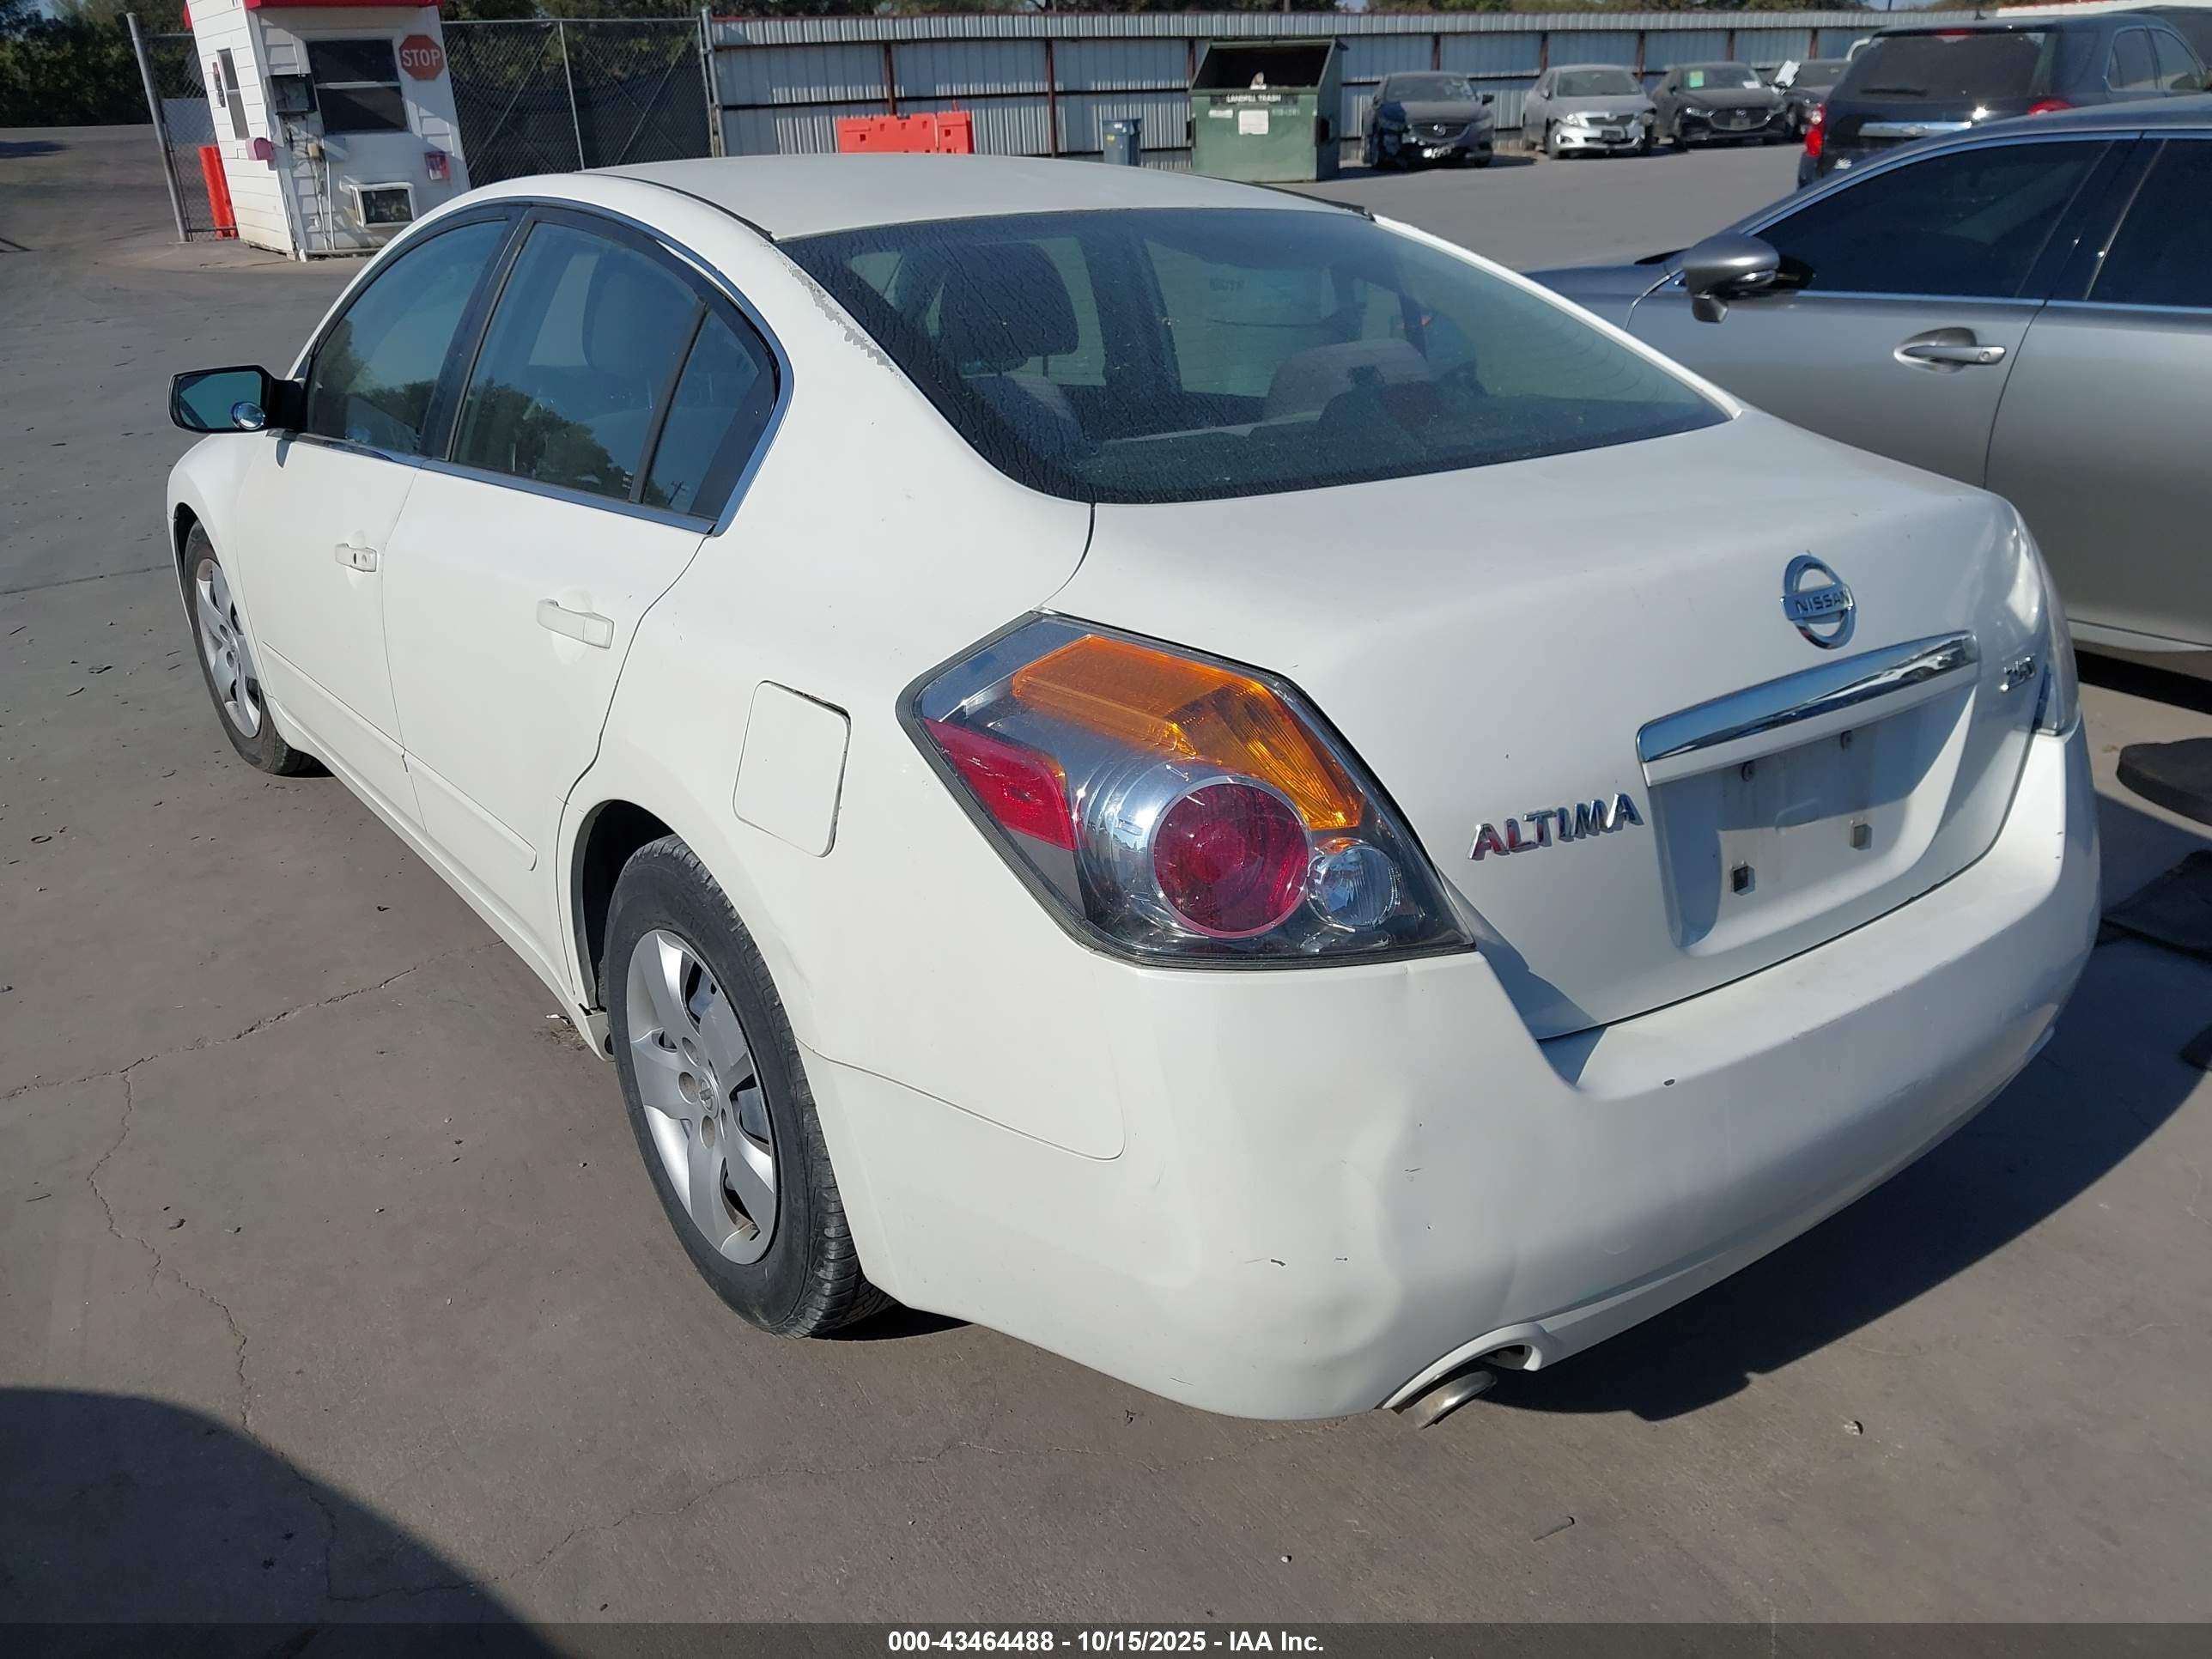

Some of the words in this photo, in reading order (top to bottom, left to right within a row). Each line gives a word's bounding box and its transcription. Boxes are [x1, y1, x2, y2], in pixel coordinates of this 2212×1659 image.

[402, 49, 441, 67] STOP
[1794, 591, 1852, 615] NISSAN
[1468, 792, 1645, 860] ALTIMA
